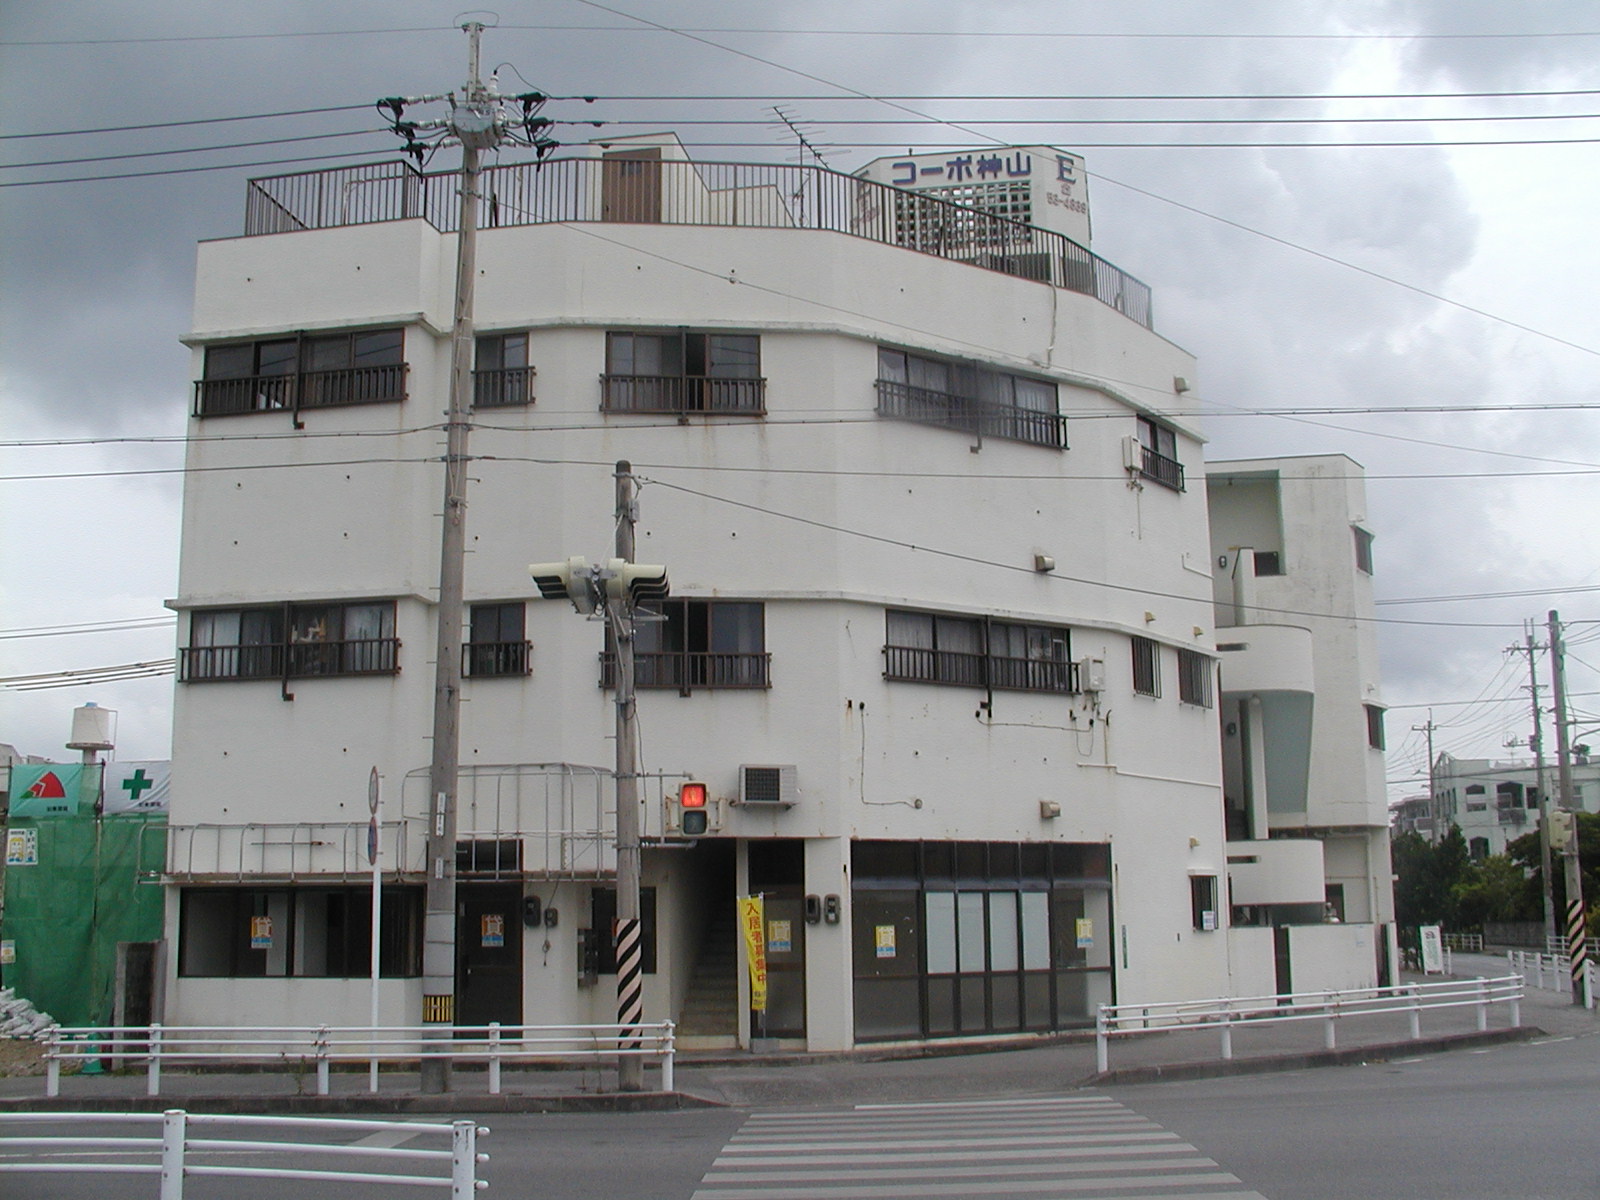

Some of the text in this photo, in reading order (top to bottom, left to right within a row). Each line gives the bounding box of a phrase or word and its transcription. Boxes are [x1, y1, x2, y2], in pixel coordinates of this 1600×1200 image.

[892, 152, 1031, 185] コーポ神山
[1055, 154, 1077, 185] E
[746, 902, 767, 985] 入居者募集中
